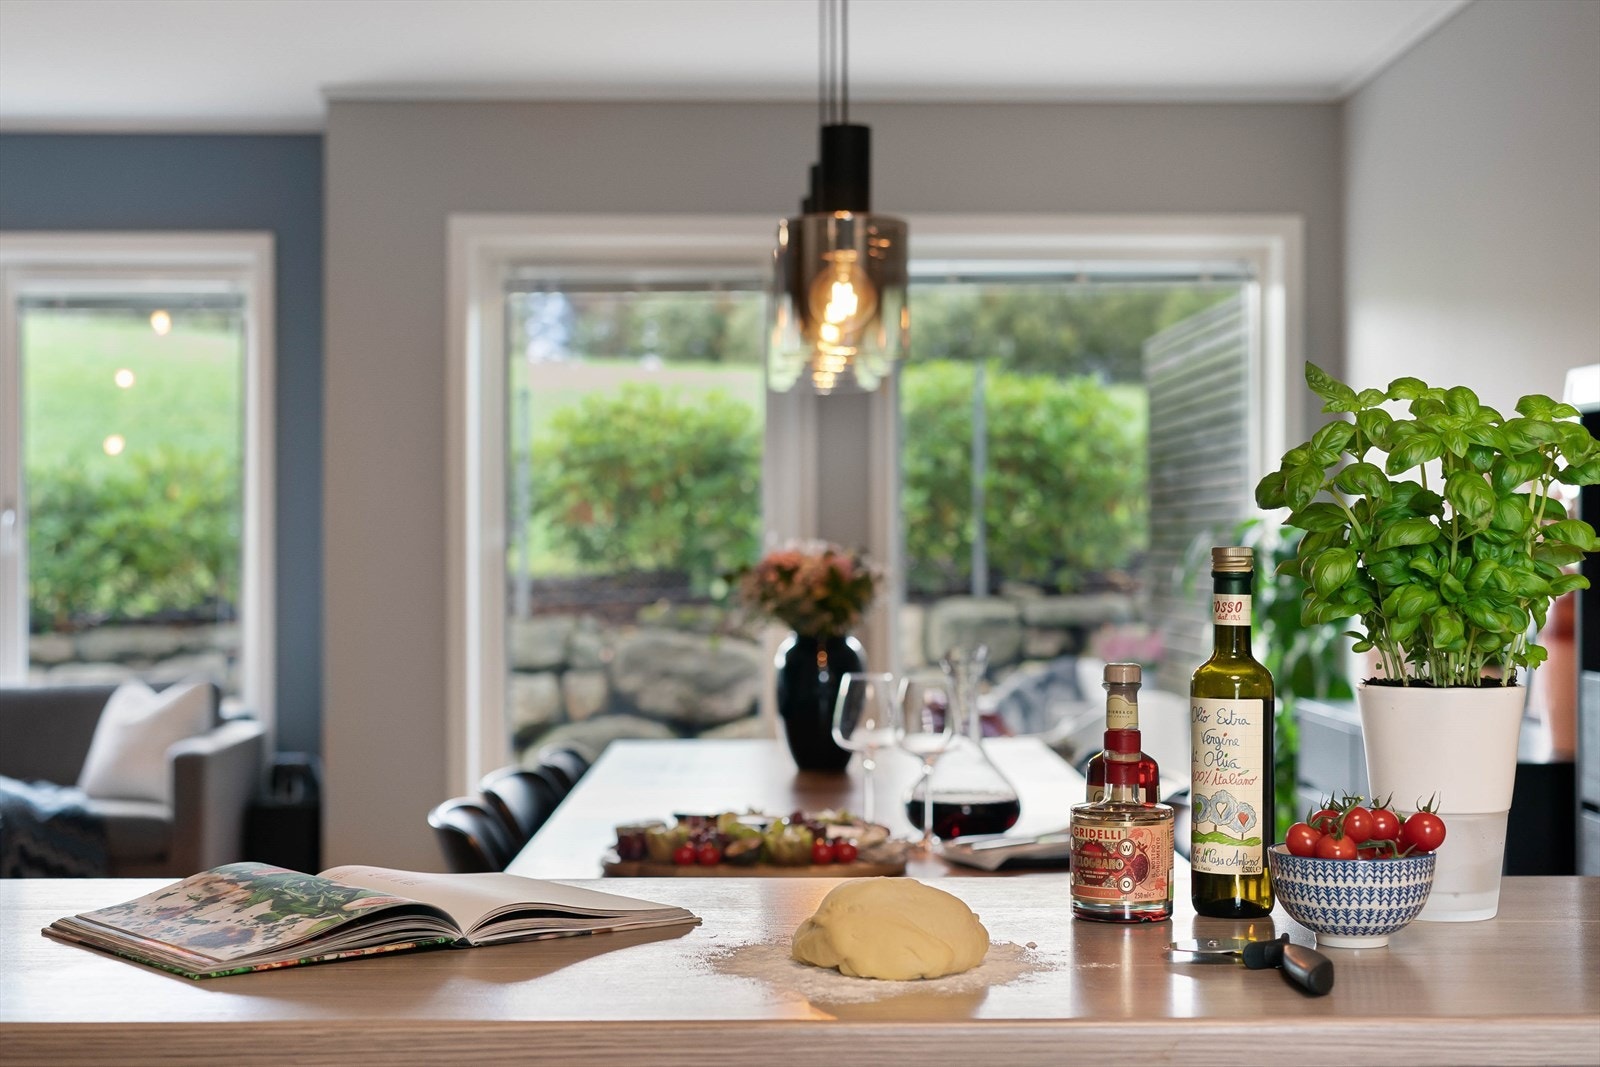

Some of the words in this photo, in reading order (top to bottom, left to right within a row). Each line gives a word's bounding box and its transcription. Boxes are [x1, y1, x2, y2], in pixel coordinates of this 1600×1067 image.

[1191, 706, 1211, 723] Olio
[1216, 708, 1251, 726] Extra
[1201, 728, 1240, 751] Vergine
[1204, 750, 1242, 769] Oliva
[1073, 826, 1121, 840] GRIDELLI
[1122, 844, 1131, 852] W
